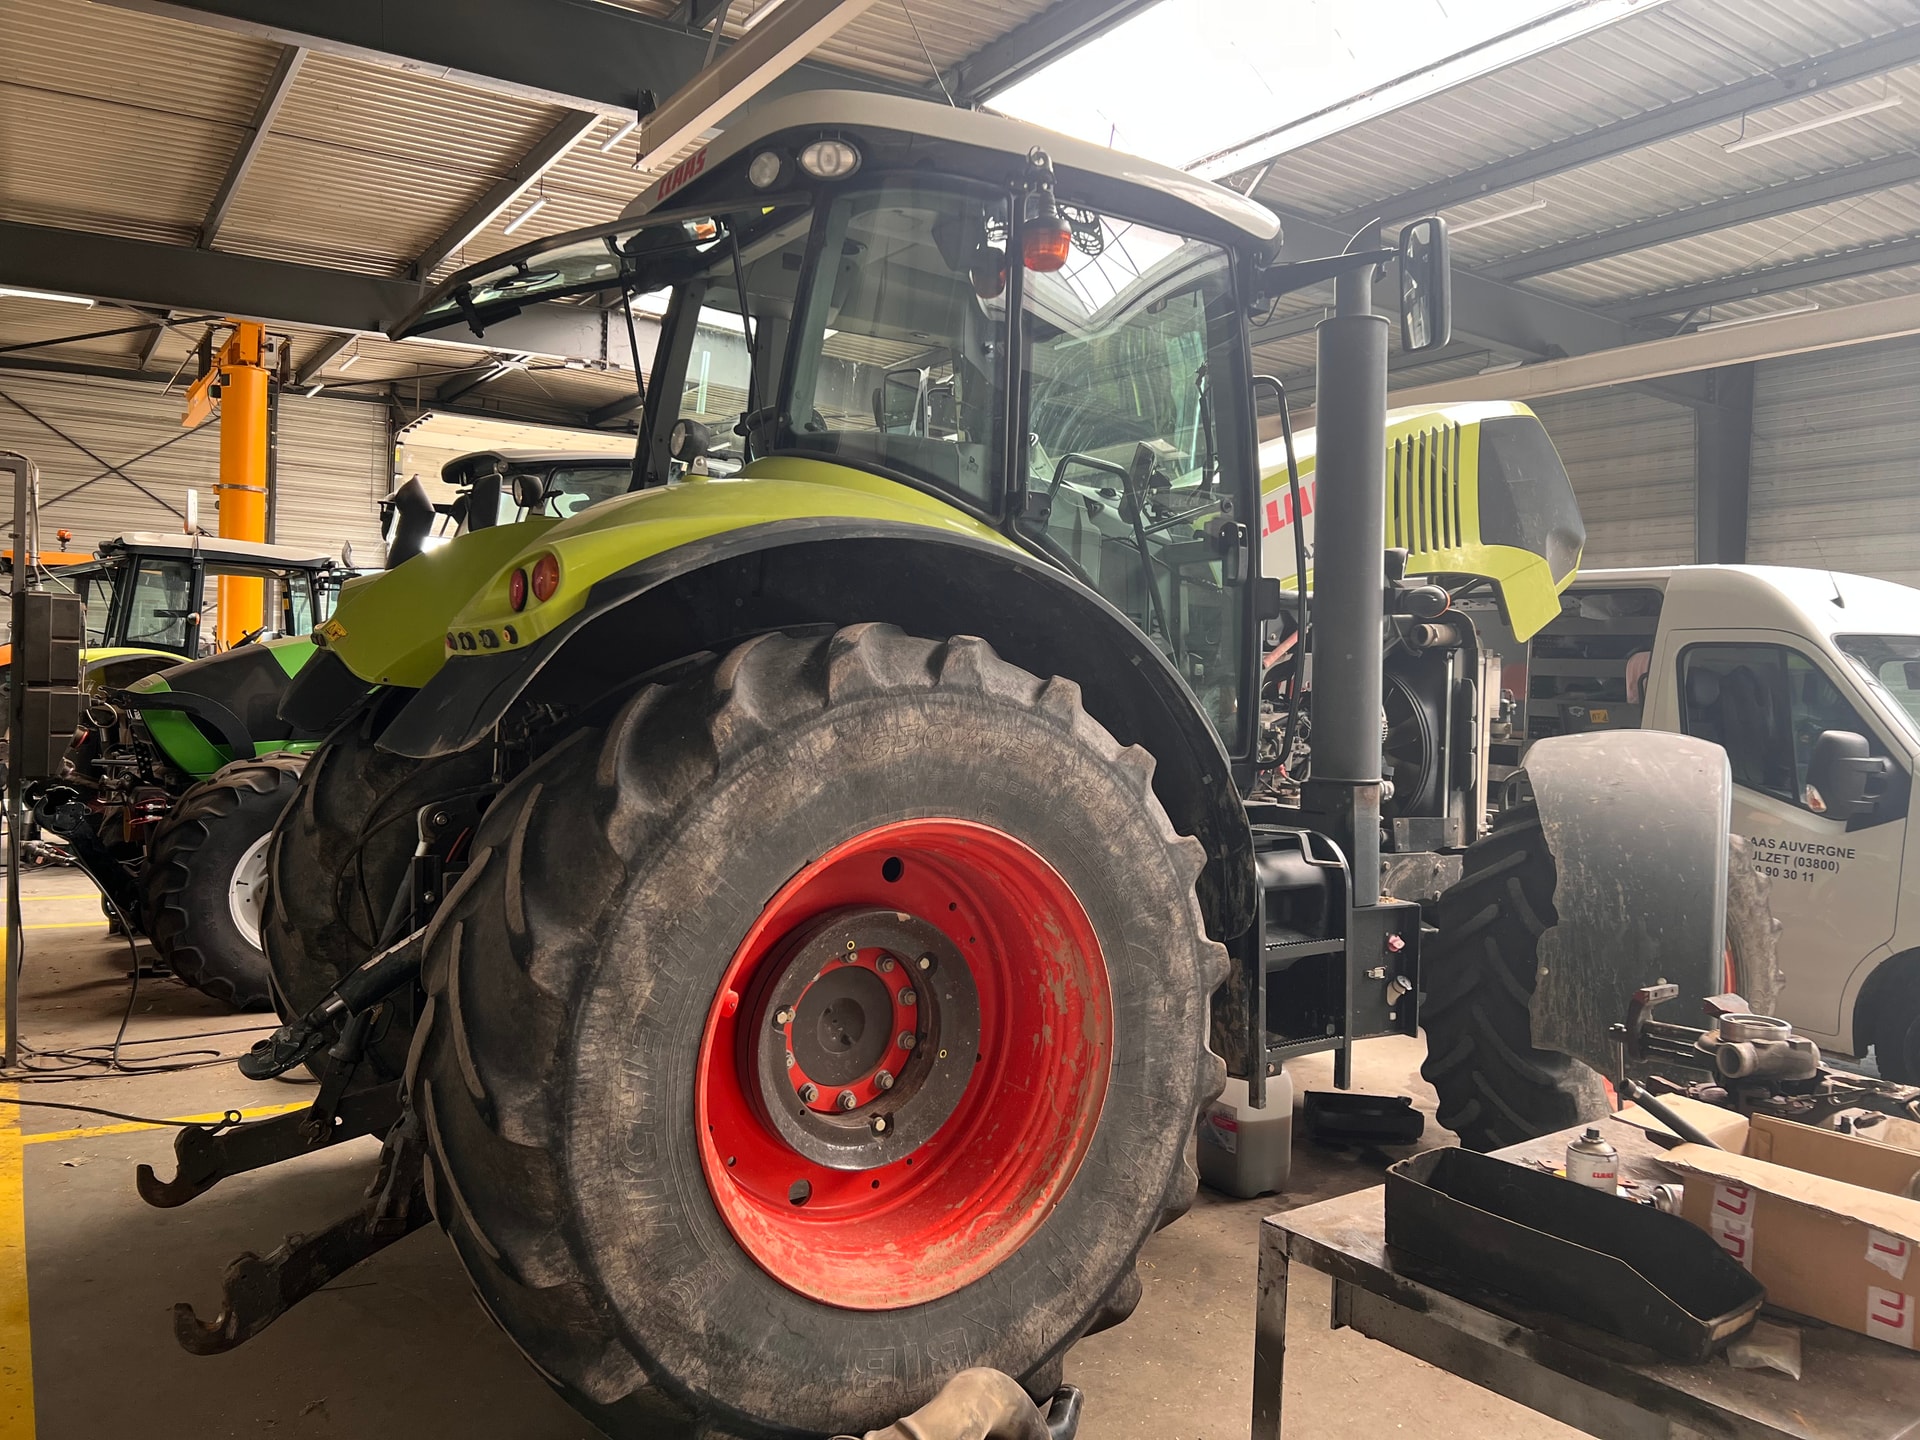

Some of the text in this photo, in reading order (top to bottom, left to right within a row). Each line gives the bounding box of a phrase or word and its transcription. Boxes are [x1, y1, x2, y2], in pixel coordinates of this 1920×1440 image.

[657, 146, 708, 201] CLAAS
[1751, 837, 1855, 859] AAS AUVERGNE
[1794, 856, 1840, 873] (03800)
[1766, 867, 1779, 877] 90
[1783, 869, 1797, 880] 30
[1802, 872, 1815, 884] 11
